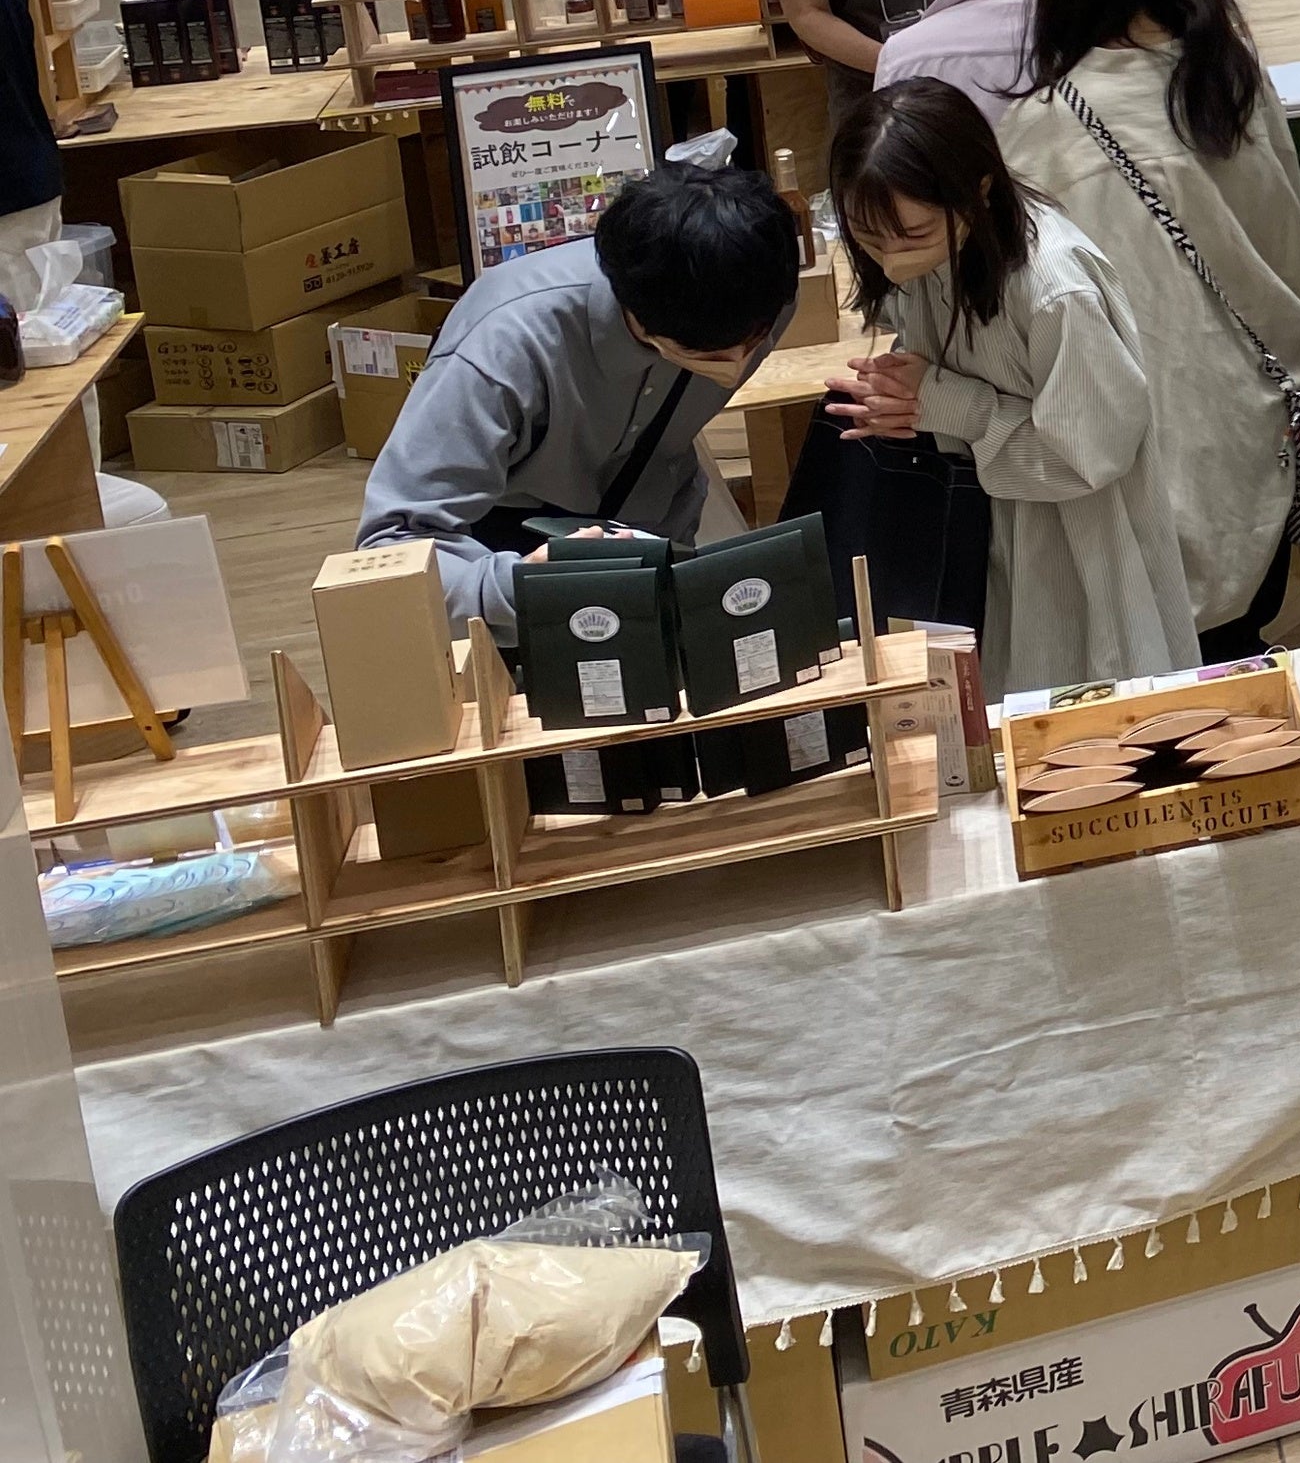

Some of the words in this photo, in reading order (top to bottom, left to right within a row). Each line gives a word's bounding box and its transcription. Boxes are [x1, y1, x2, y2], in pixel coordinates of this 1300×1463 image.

[470, 129, 639, 171] 試飲コーナー
[889, 1308, 1002, 1360] KATO
[939, 1357, 1086, 1424] 青森県産
